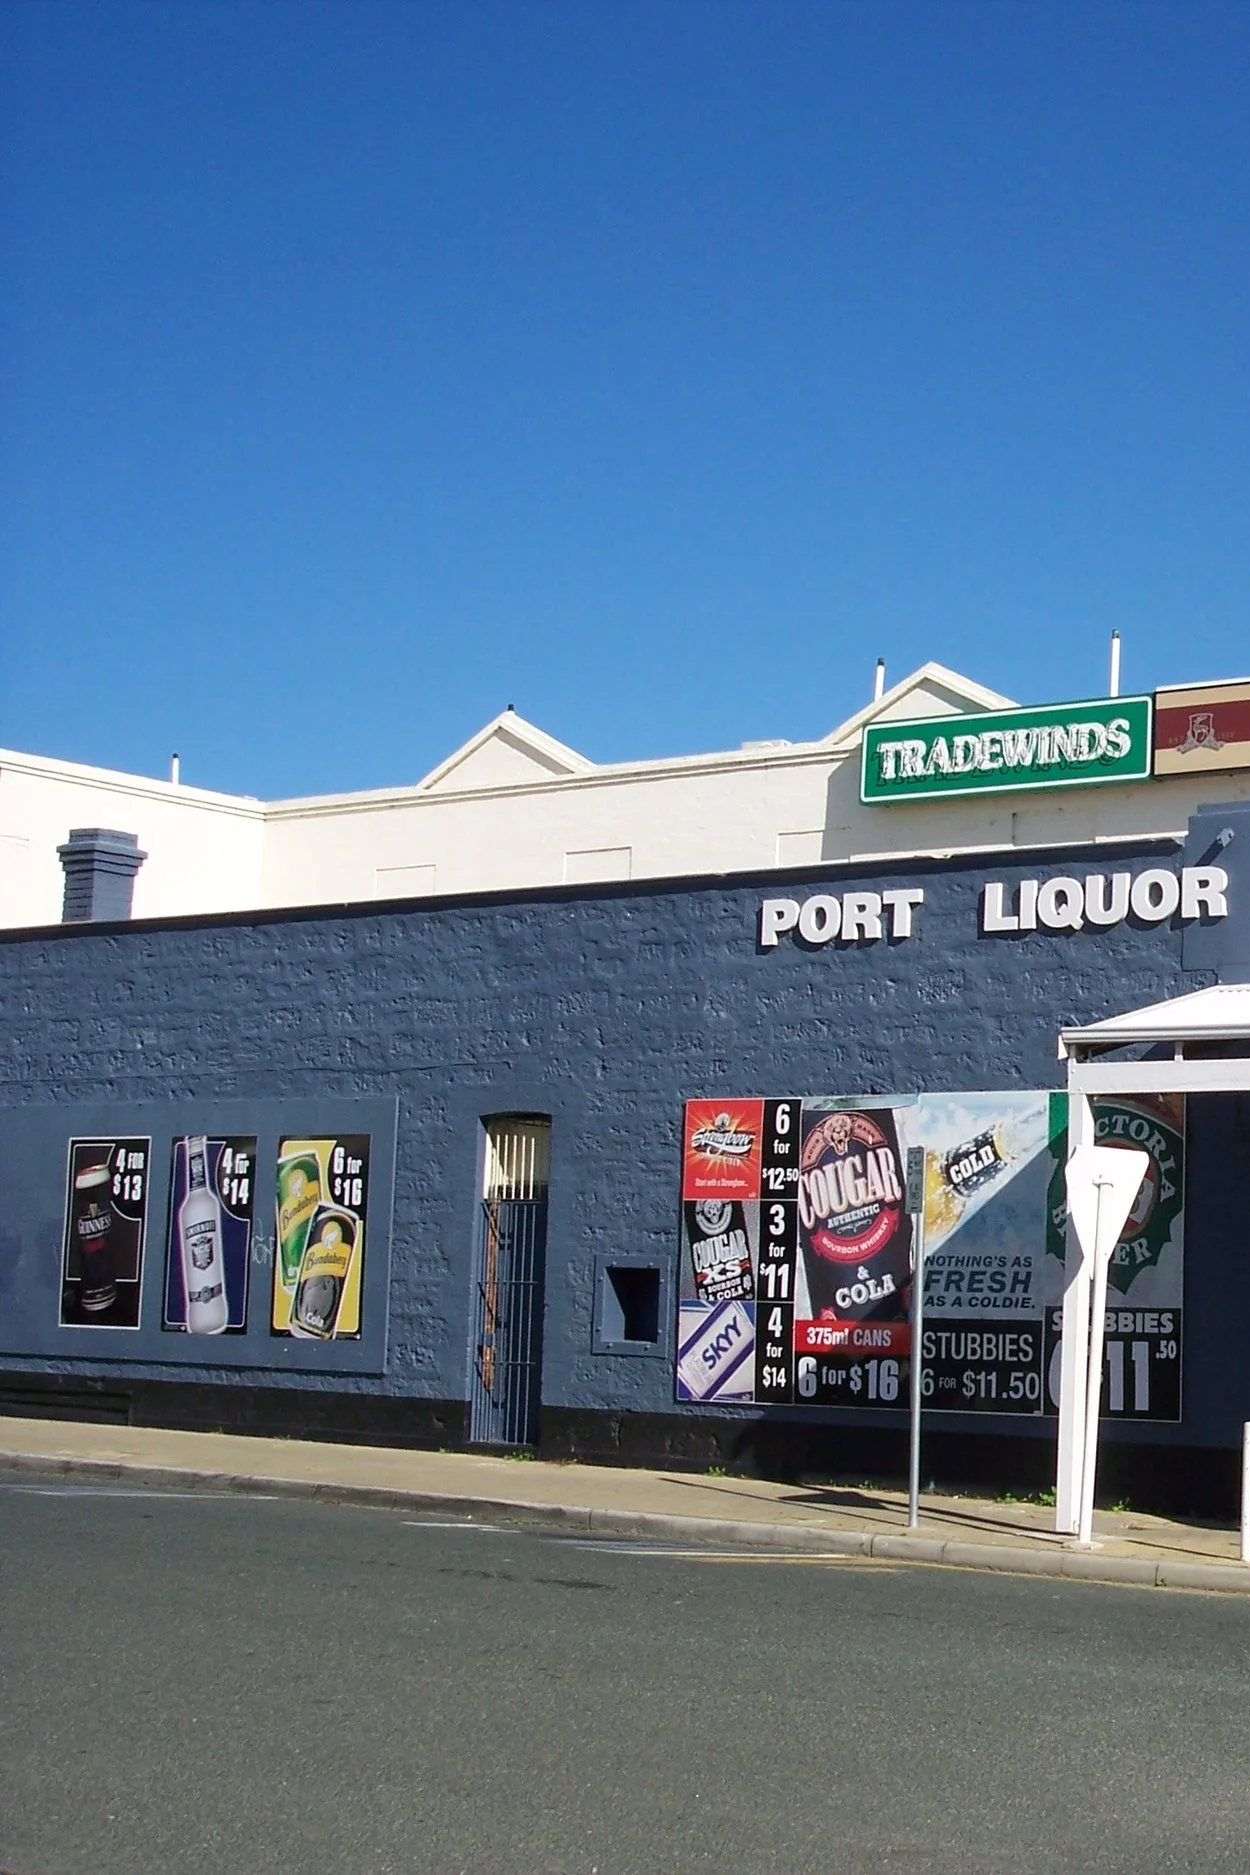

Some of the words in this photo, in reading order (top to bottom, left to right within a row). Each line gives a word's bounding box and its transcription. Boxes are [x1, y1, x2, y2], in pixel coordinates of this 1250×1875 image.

[878, 718, 1133, 780] TRADEWINDS
[760, 888, 924, 946] PORT
[983, 866, 1229, 932] LIQUOR
[775, 1104, 790, 1134] 6
[773, 1139, 790, 1154] for
[1095, 1114, 1177, 1202] CTORIA
[115, 1148, 126, 1173] 4
[128, 1152, 145, 1170] FOR
[223, 1147, 233, 1175] 4
[333, 1147, 345, 1175] 6
[347, 1156, 362, 1174] for
[949, 1145, 996, 1184] COLD
[113, 1173, 143, 1200] $13
[223, 1176, 250, 1205] $14
[334, 1177, 363, 1206] $16
[762, 1167, 799, 1190] $12.50
[798, 1147, 902, 1229] COUGAR
[78, 1213, 113, 1236] GUINNESS
[769, 1204, 785, 1236] 3
[827, 1203, 880, 1229] AUTHENTIC
[692, 1228, 749, 1273] COUGAR
[768, 1242, 785, 1258] for
[822, 1236, 859, 1255] BOURBON
[702, 1259, 744, 1284] XS
[857, 1266, 870, 1280] &
[924, 1255, 1008, 1268] NOTHING'S
[1011, 1256, 1033, 1268] AS
[707, 1276, 742, 1293] BOURBON
[716, 1285, 744, 1301] COLA
[760, 1262, 789, 1298] $11
[835, 1274, 896, 1309] COLA
[923, 1270, 1033, 1293] FRESH
[923, 1295, 946, 1307] AS
[951, 1296, 963, 1307] A
[968, 1296, 1035, 1309] COLDIE.
[306, 1312, 325, 1328] Cola
[767, 1307, 783, 1338] 4
[701, 1316, 745, 1370] SKYY
[766, 1343, 783, 1358] for
[853, 1329, 892, 1347] CANS
[923, 1331, 1034, 1362] STUBBIES
[762, 1367, 787, 1388] $14
[798, 1356, 817, 1397] 6
[822, 1366, 846, 1384] for
[850, 1359, 899, 1400] $16
[921, 1368, 935, 1396] 6
[938, 1377, 957, 1389] FOR
[962, 1368, 1040, 1400] $11.50
